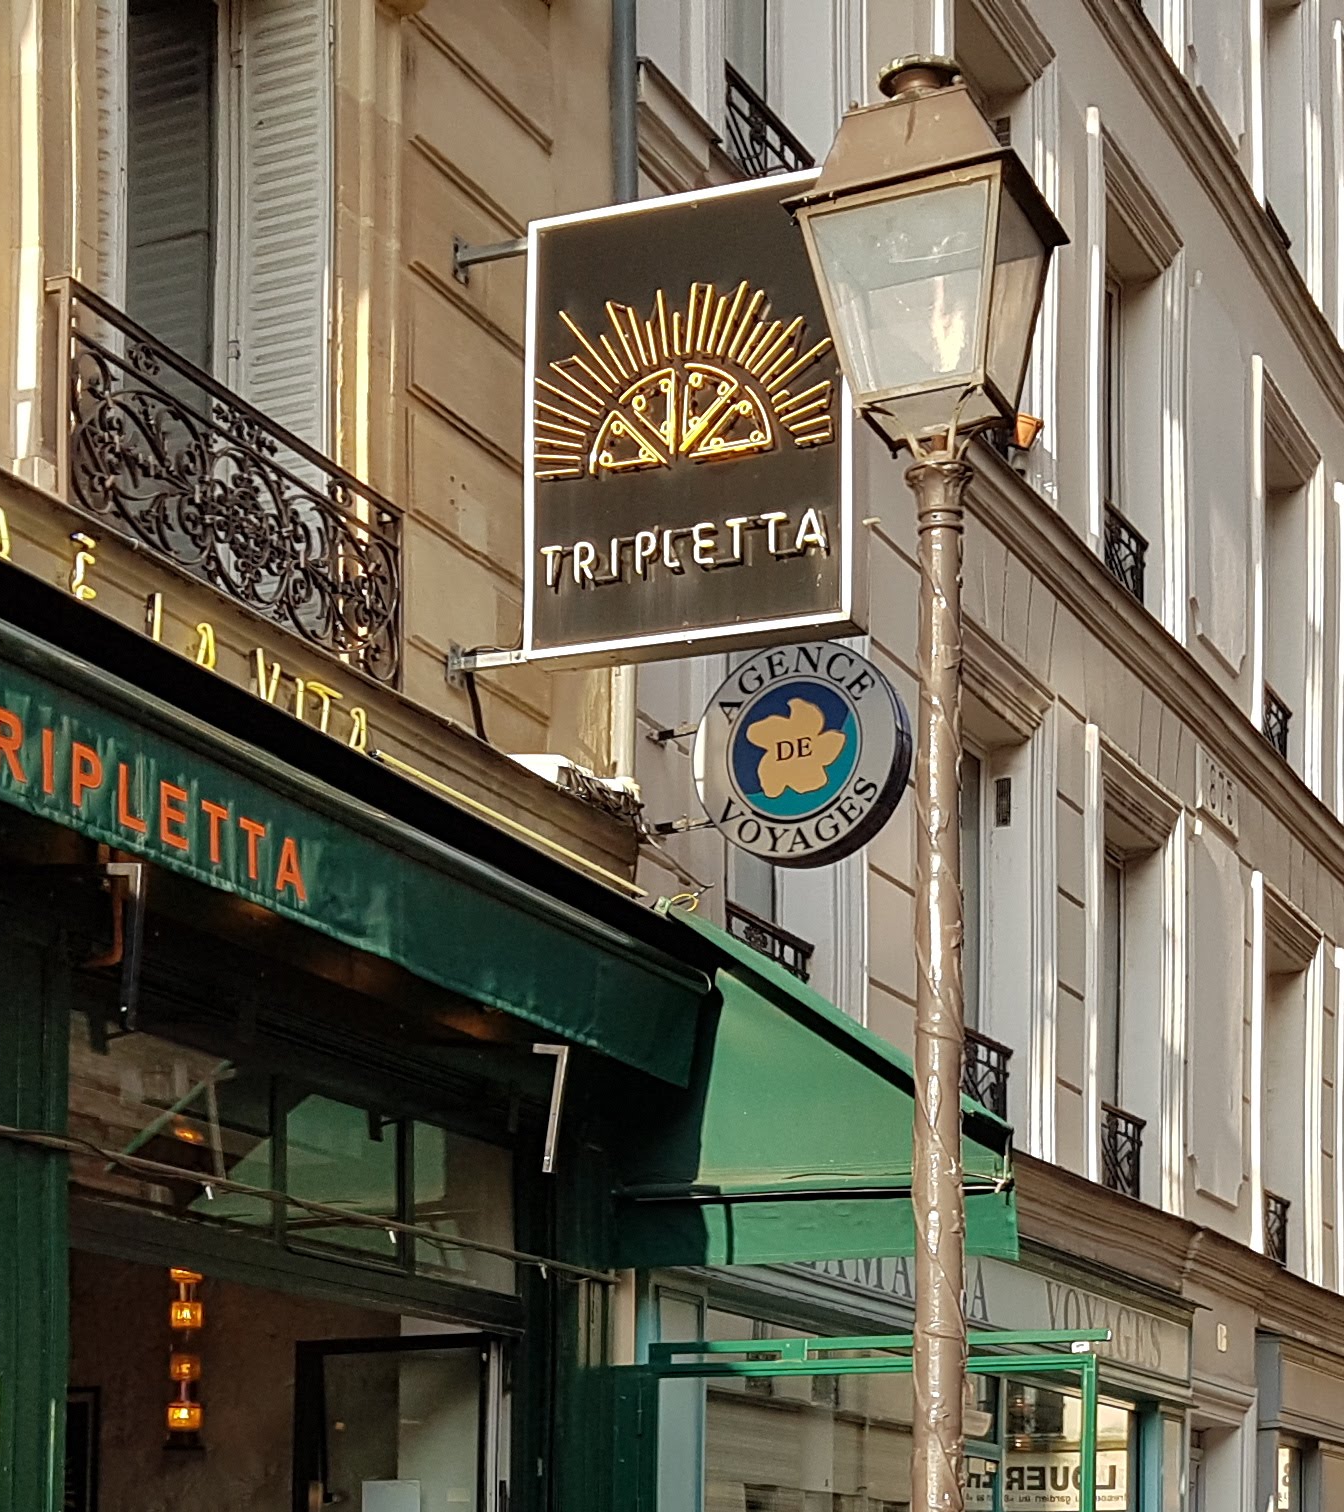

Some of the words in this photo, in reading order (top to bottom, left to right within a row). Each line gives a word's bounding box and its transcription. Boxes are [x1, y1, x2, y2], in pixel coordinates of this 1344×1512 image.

[540, 507, 827, 587] TRIPLETTA
[256, 647, 368, 755] VITA
[719, 647, 876, 725] AGENCE
[776, 737, 813, 761] DE
[720, 776, 879, 853] VOYAGES
[1045, 1279, 1163, 1371] VOYAGES
